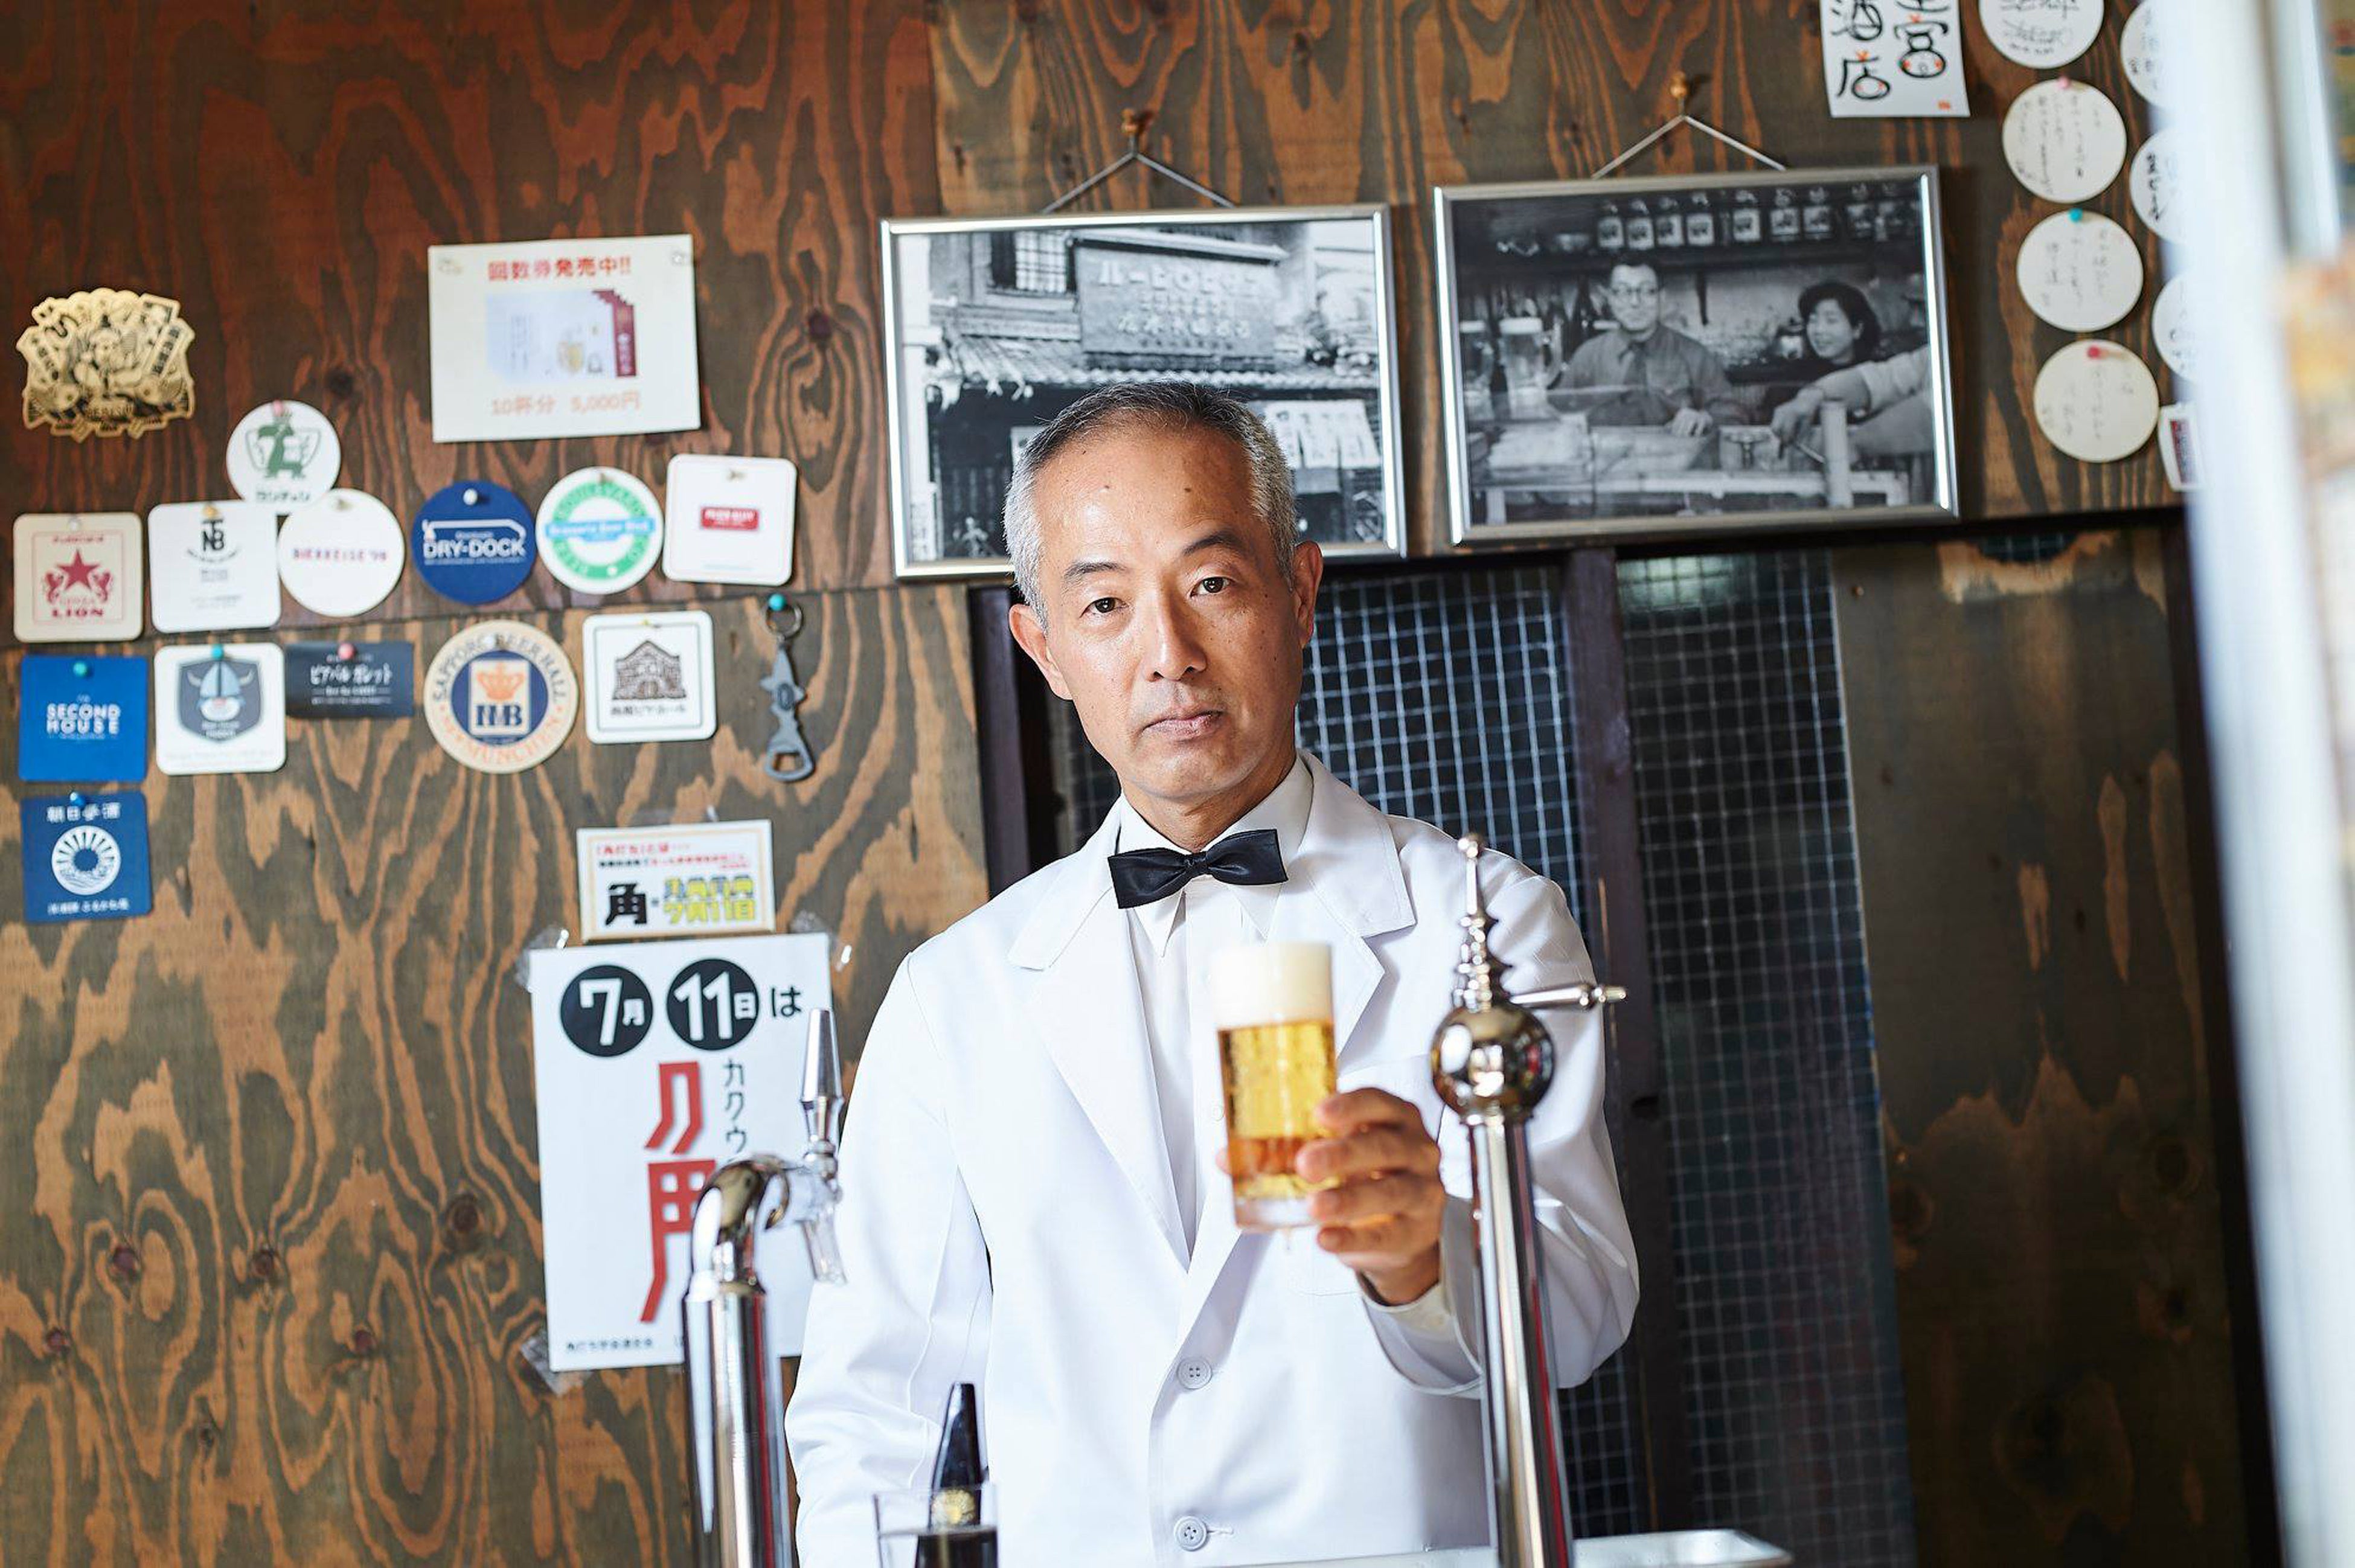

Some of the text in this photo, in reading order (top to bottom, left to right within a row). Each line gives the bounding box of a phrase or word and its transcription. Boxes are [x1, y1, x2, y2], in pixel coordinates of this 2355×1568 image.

[423, 538, 526, 559] DRY-DOCK
[52, 609, 103, 618] LION
[46, 703, 121, 719] SECOND
[46, 719, 120, 734] HOUSE
[605, 882, 648, 926] 角
[771, 985, 802, 1018] は
